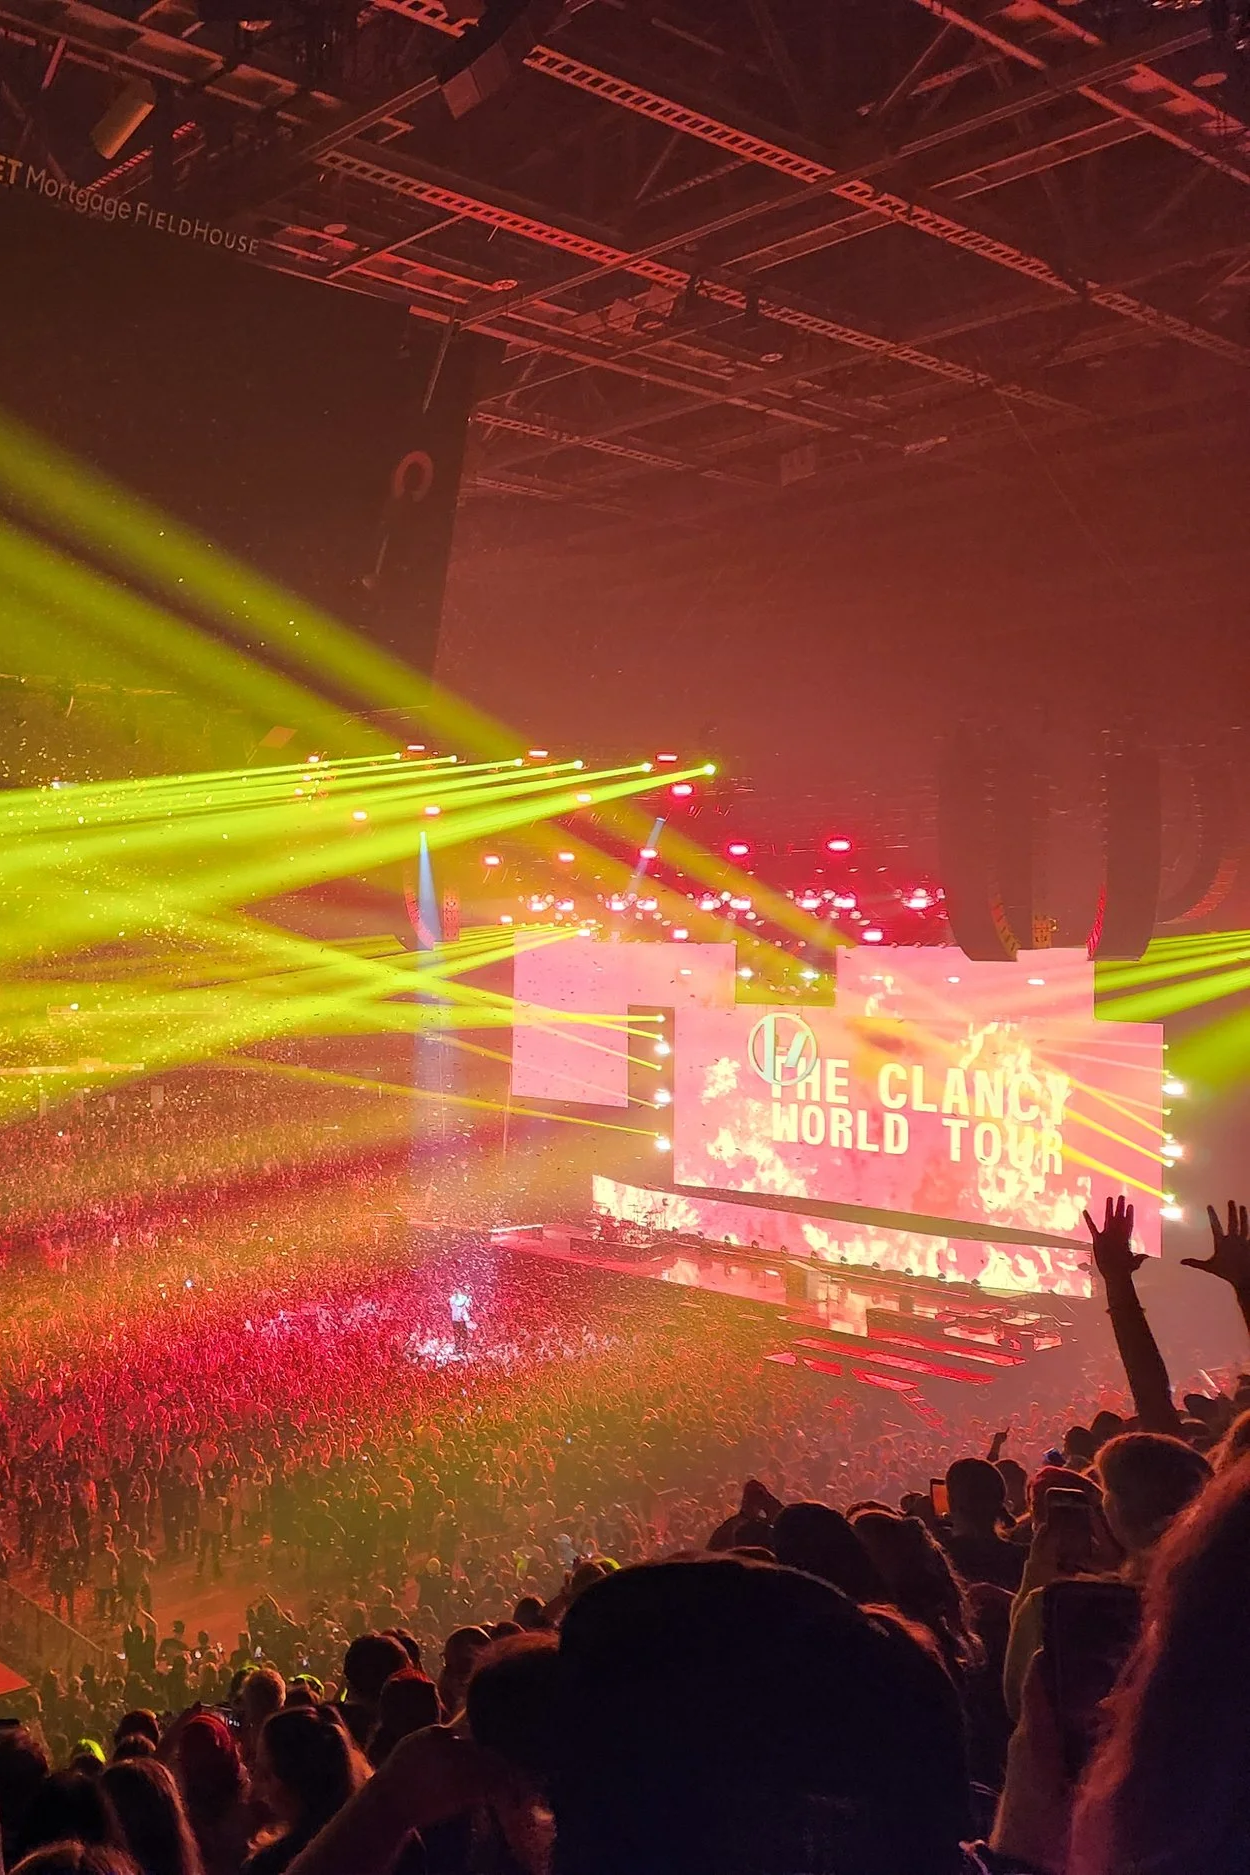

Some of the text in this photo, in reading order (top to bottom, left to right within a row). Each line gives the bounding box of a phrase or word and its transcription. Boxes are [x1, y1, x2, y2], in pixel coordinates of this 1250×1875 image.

[26, 165, 133, 221] Mortgage
[878, 1062, 1071, 1126] CLANCY
[771, 1101, 1063, 1175] WORLD TOUR
